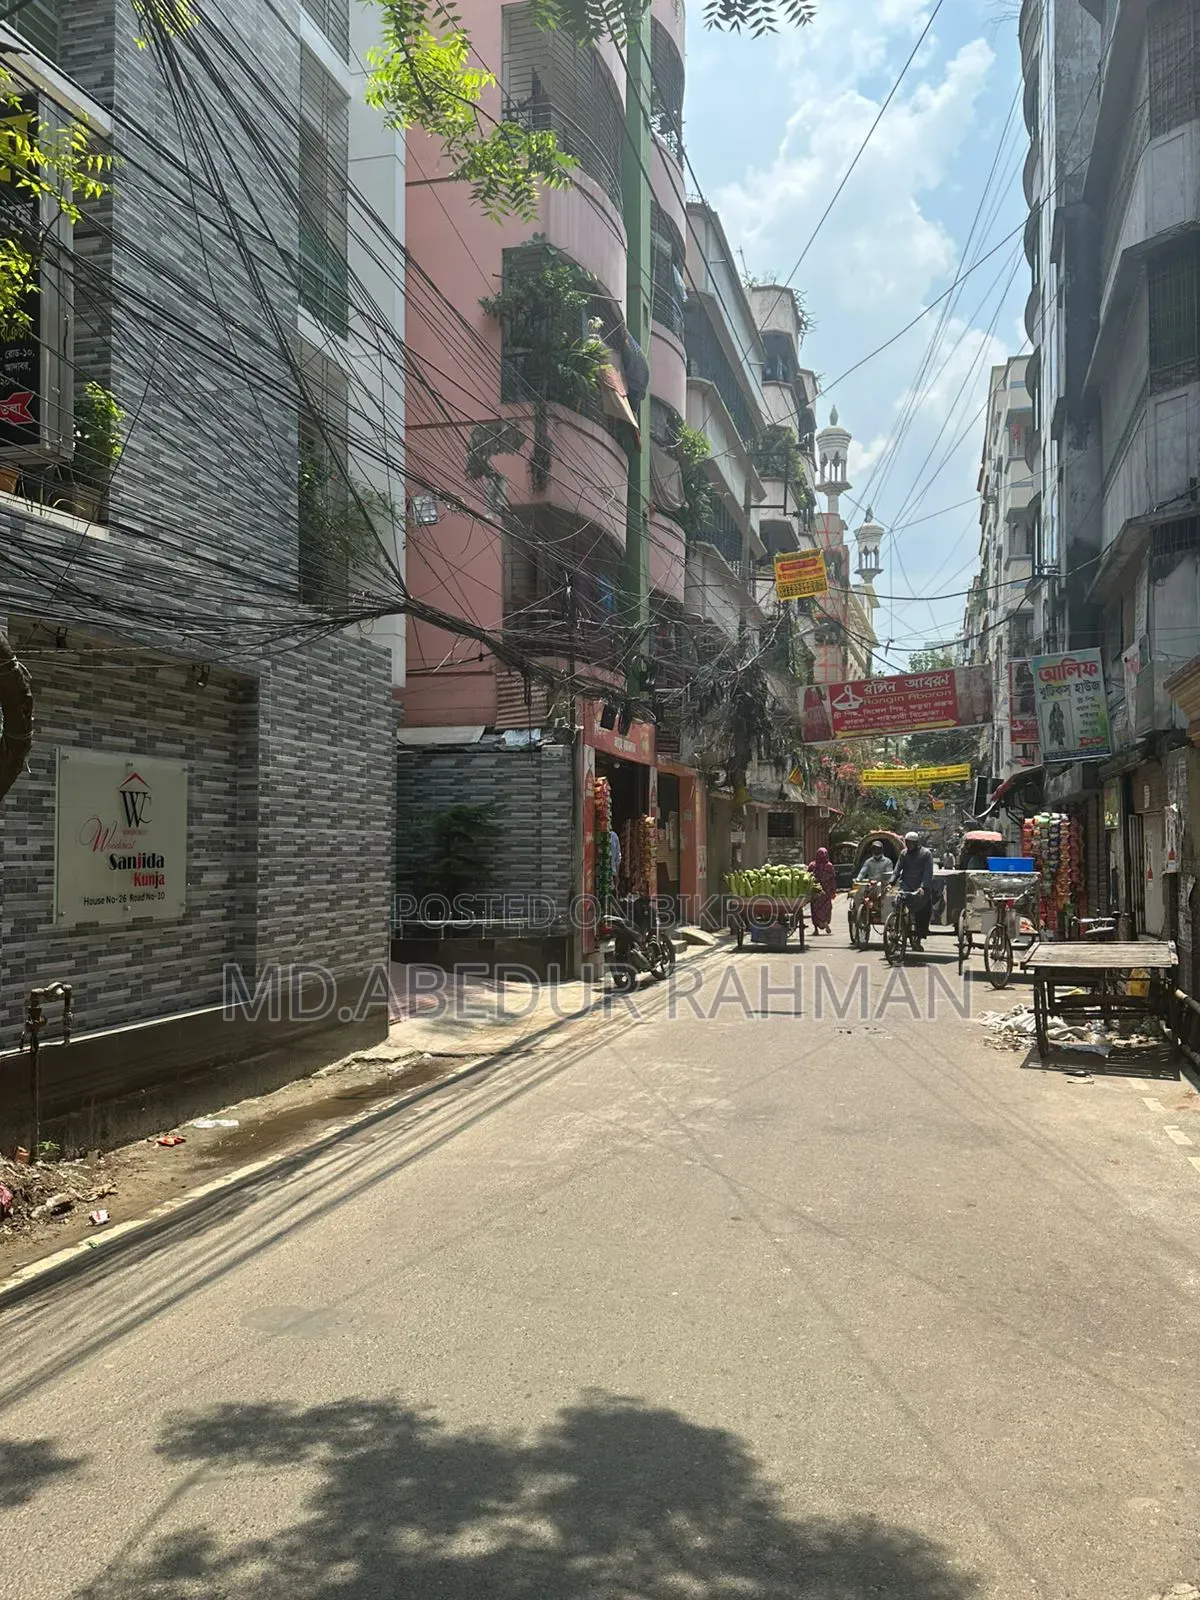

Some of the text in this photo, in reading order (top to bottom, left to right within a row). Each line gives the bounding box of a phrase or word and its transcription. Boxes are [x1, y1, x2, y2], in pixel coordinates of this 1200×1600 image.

[1038, 657, 1099, 682] আলিফ
[905, 673, 951, 689] আবরণ
[863, 689, 952, 706] Rongin Aboron
[109, 852, 165, 871] Sanjida
[133, 871, 165, 889] Kunja
[84, 896, 105, 906] House
[129, 893, 145, 903] Road
